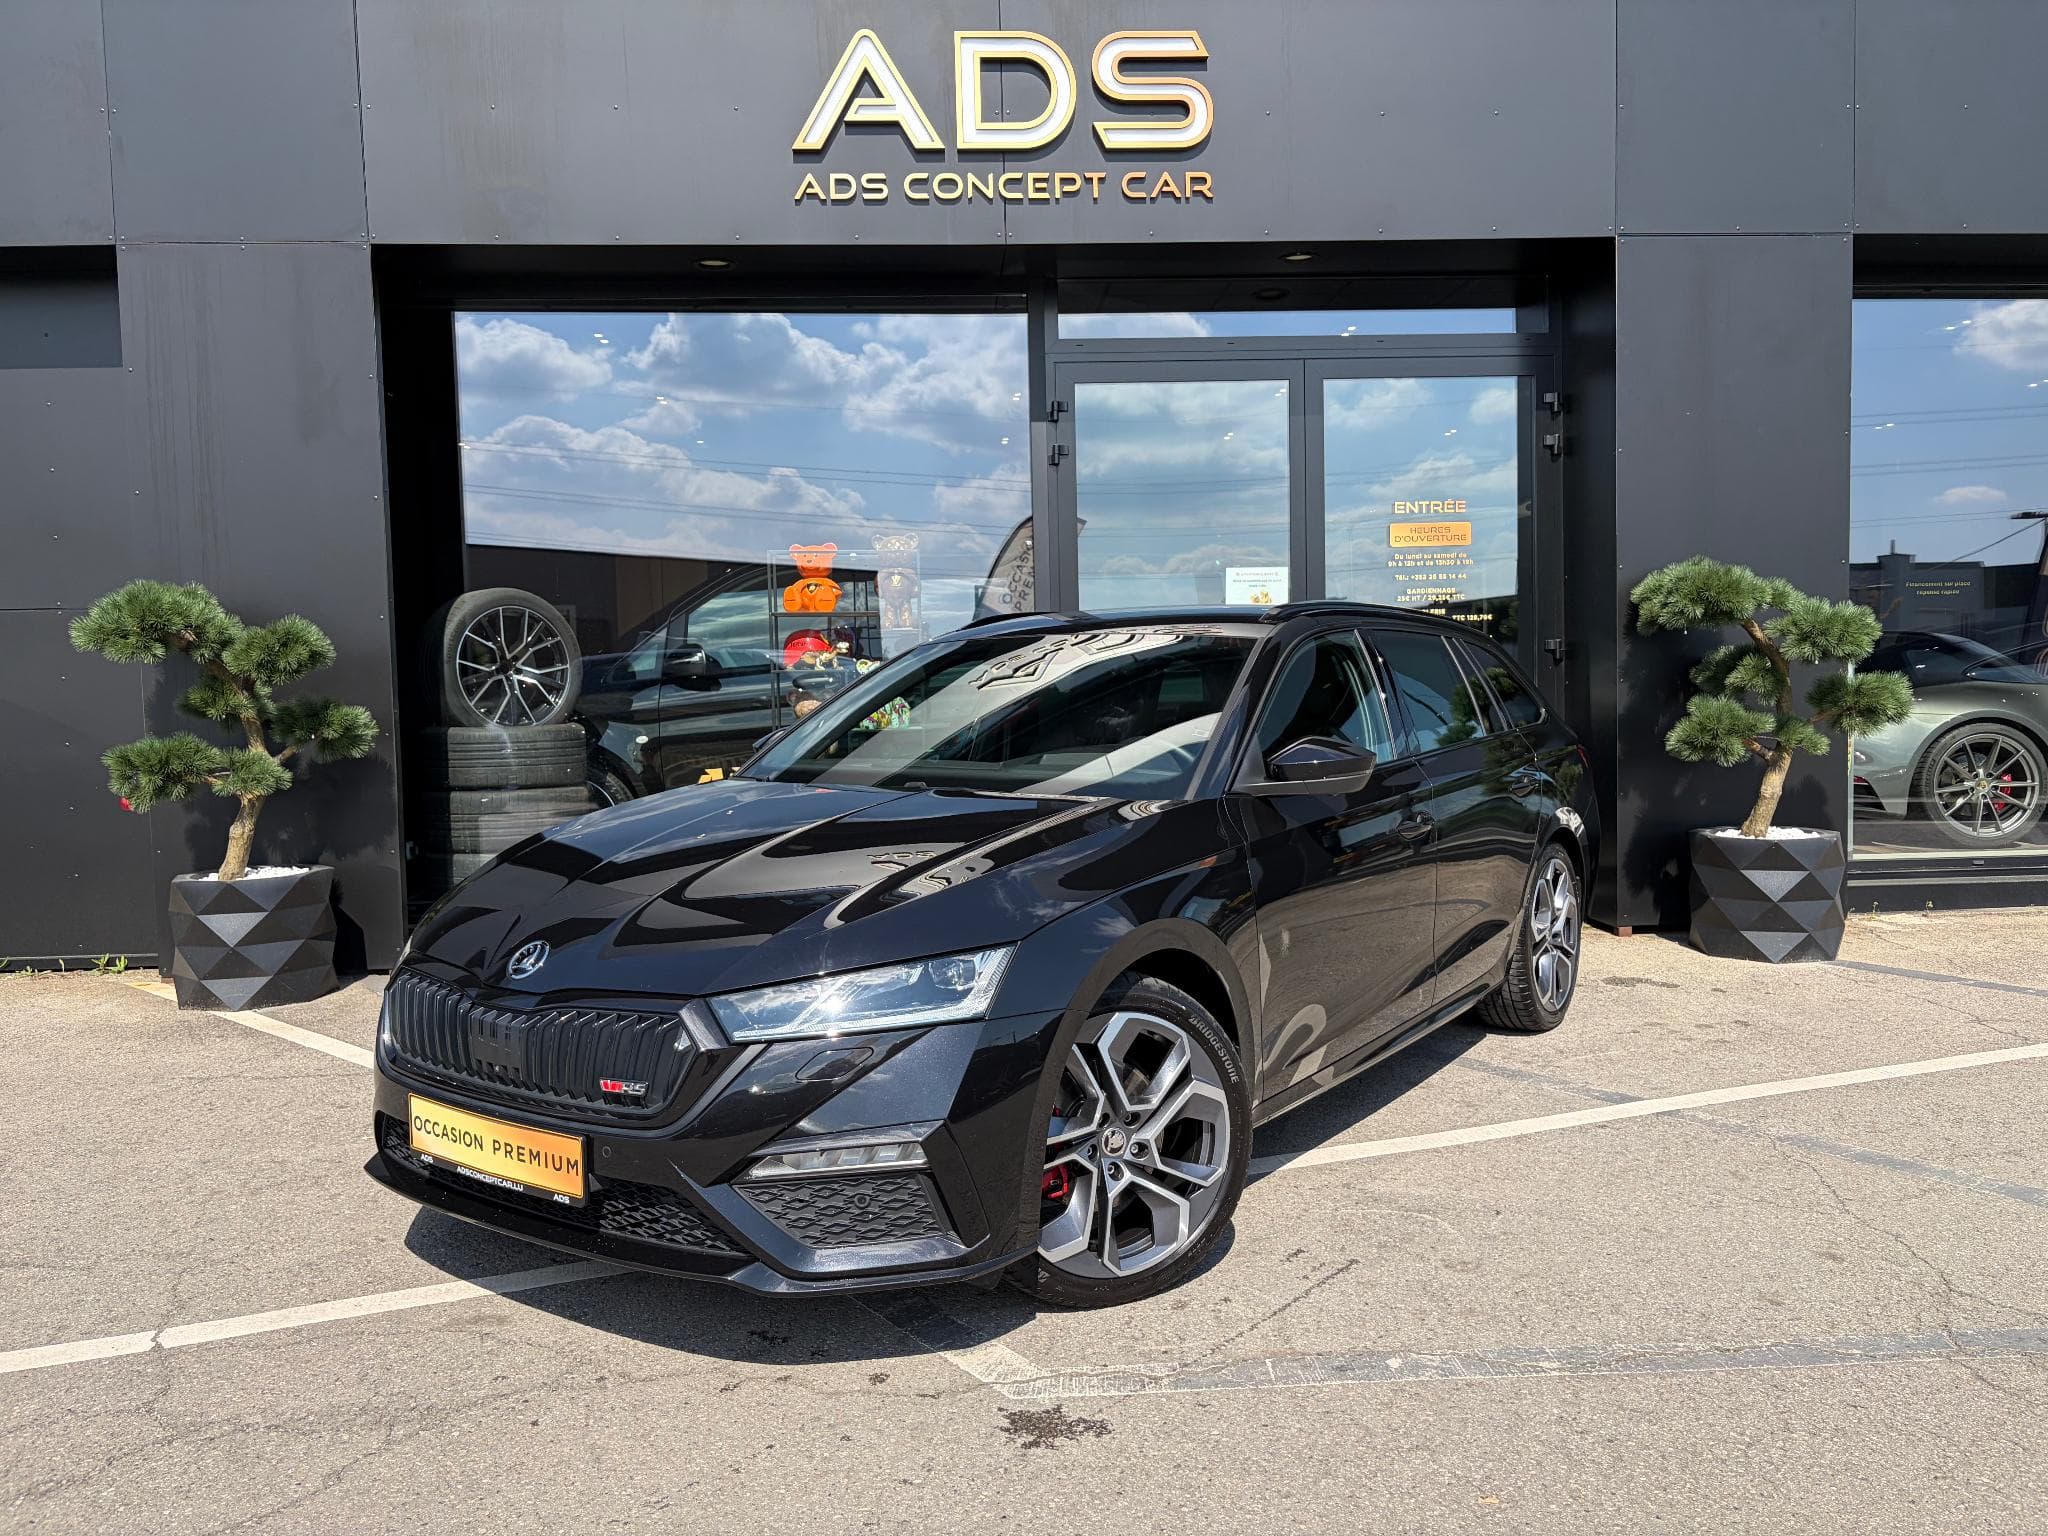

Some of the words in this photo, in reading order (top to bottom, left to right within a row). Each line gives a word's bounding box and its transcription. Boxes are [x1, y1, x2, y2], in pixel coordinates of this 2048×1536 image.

[792, 28, 1214, 151] ADS
[794, 172, 889, 201] ADS
[904, 171, 1107, 200] CONCEPT
[1121, 171, 1214, 199] CAR
[1394, 498, 1467, 514] ENTRÉE
[1394, 534, 1467, 543] D'OUVERTURE
[1409, 526, 1451, 535] HEURES
[1188, 1013, 1240, 1084] BRIDGESTONE
[413, 1115, 484, 1152] OCCASION
[492, 1139, 580, 1177] PREMIUM
[420, 1153, 434, 1164] ADS
[553, 1192, 570, 1205] ADS
